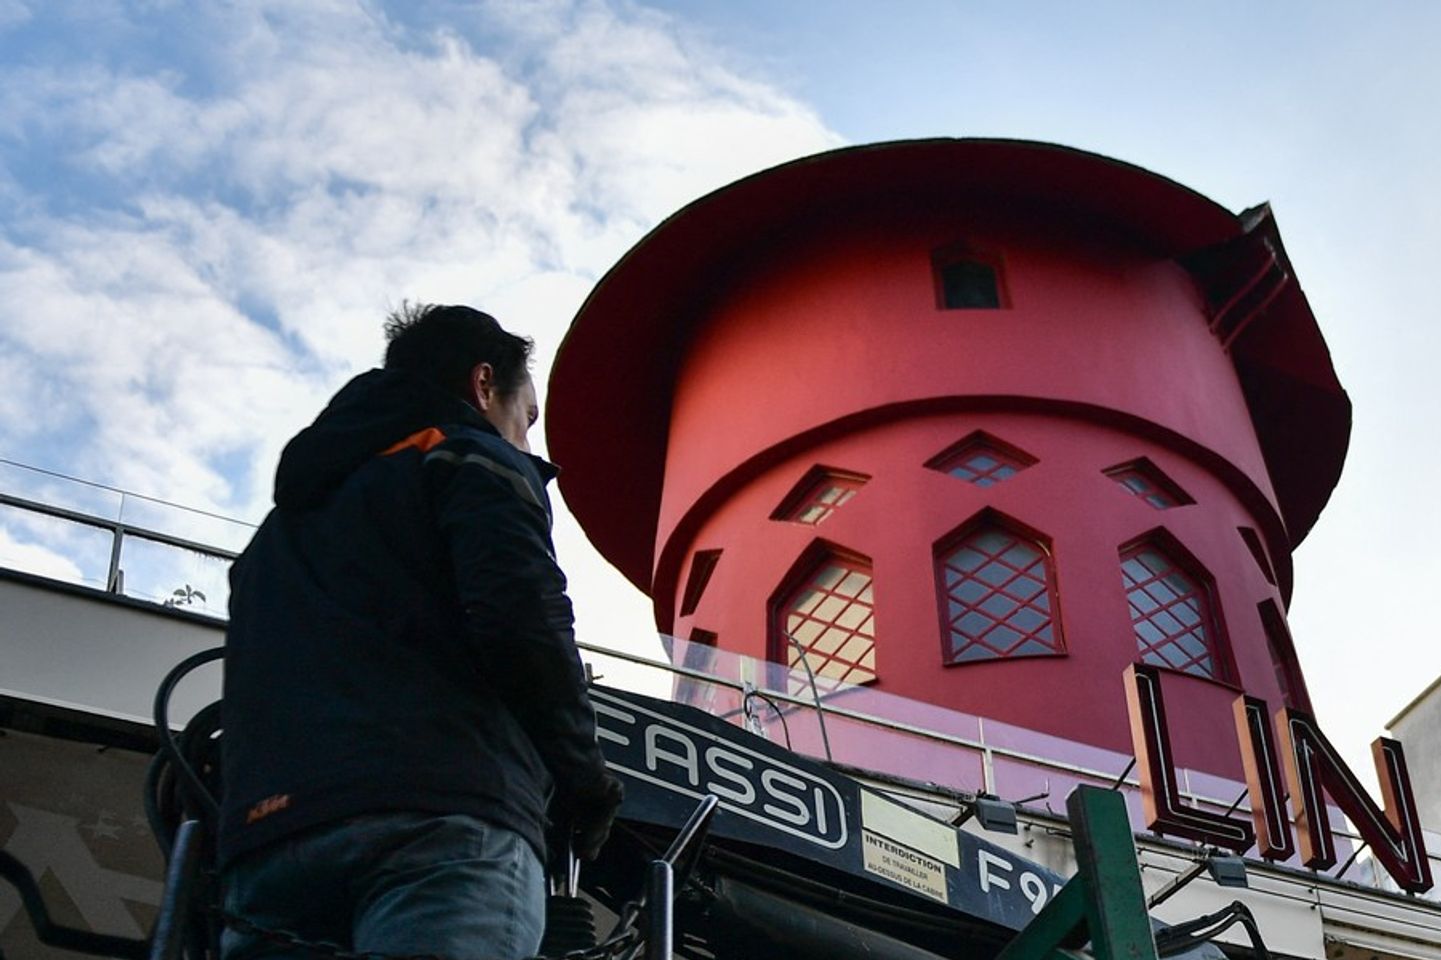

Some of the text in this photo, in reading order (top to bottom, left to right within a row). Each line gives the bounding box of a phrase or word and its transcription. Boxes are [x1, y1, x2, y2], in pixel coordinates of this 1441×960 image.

[589, 700, 827, 835] FASSI
[1123, 662, 1434, 894] LIN
[865, 834, 942, 873] INTERDICTION
[978, 849, 1063, 915] F9
